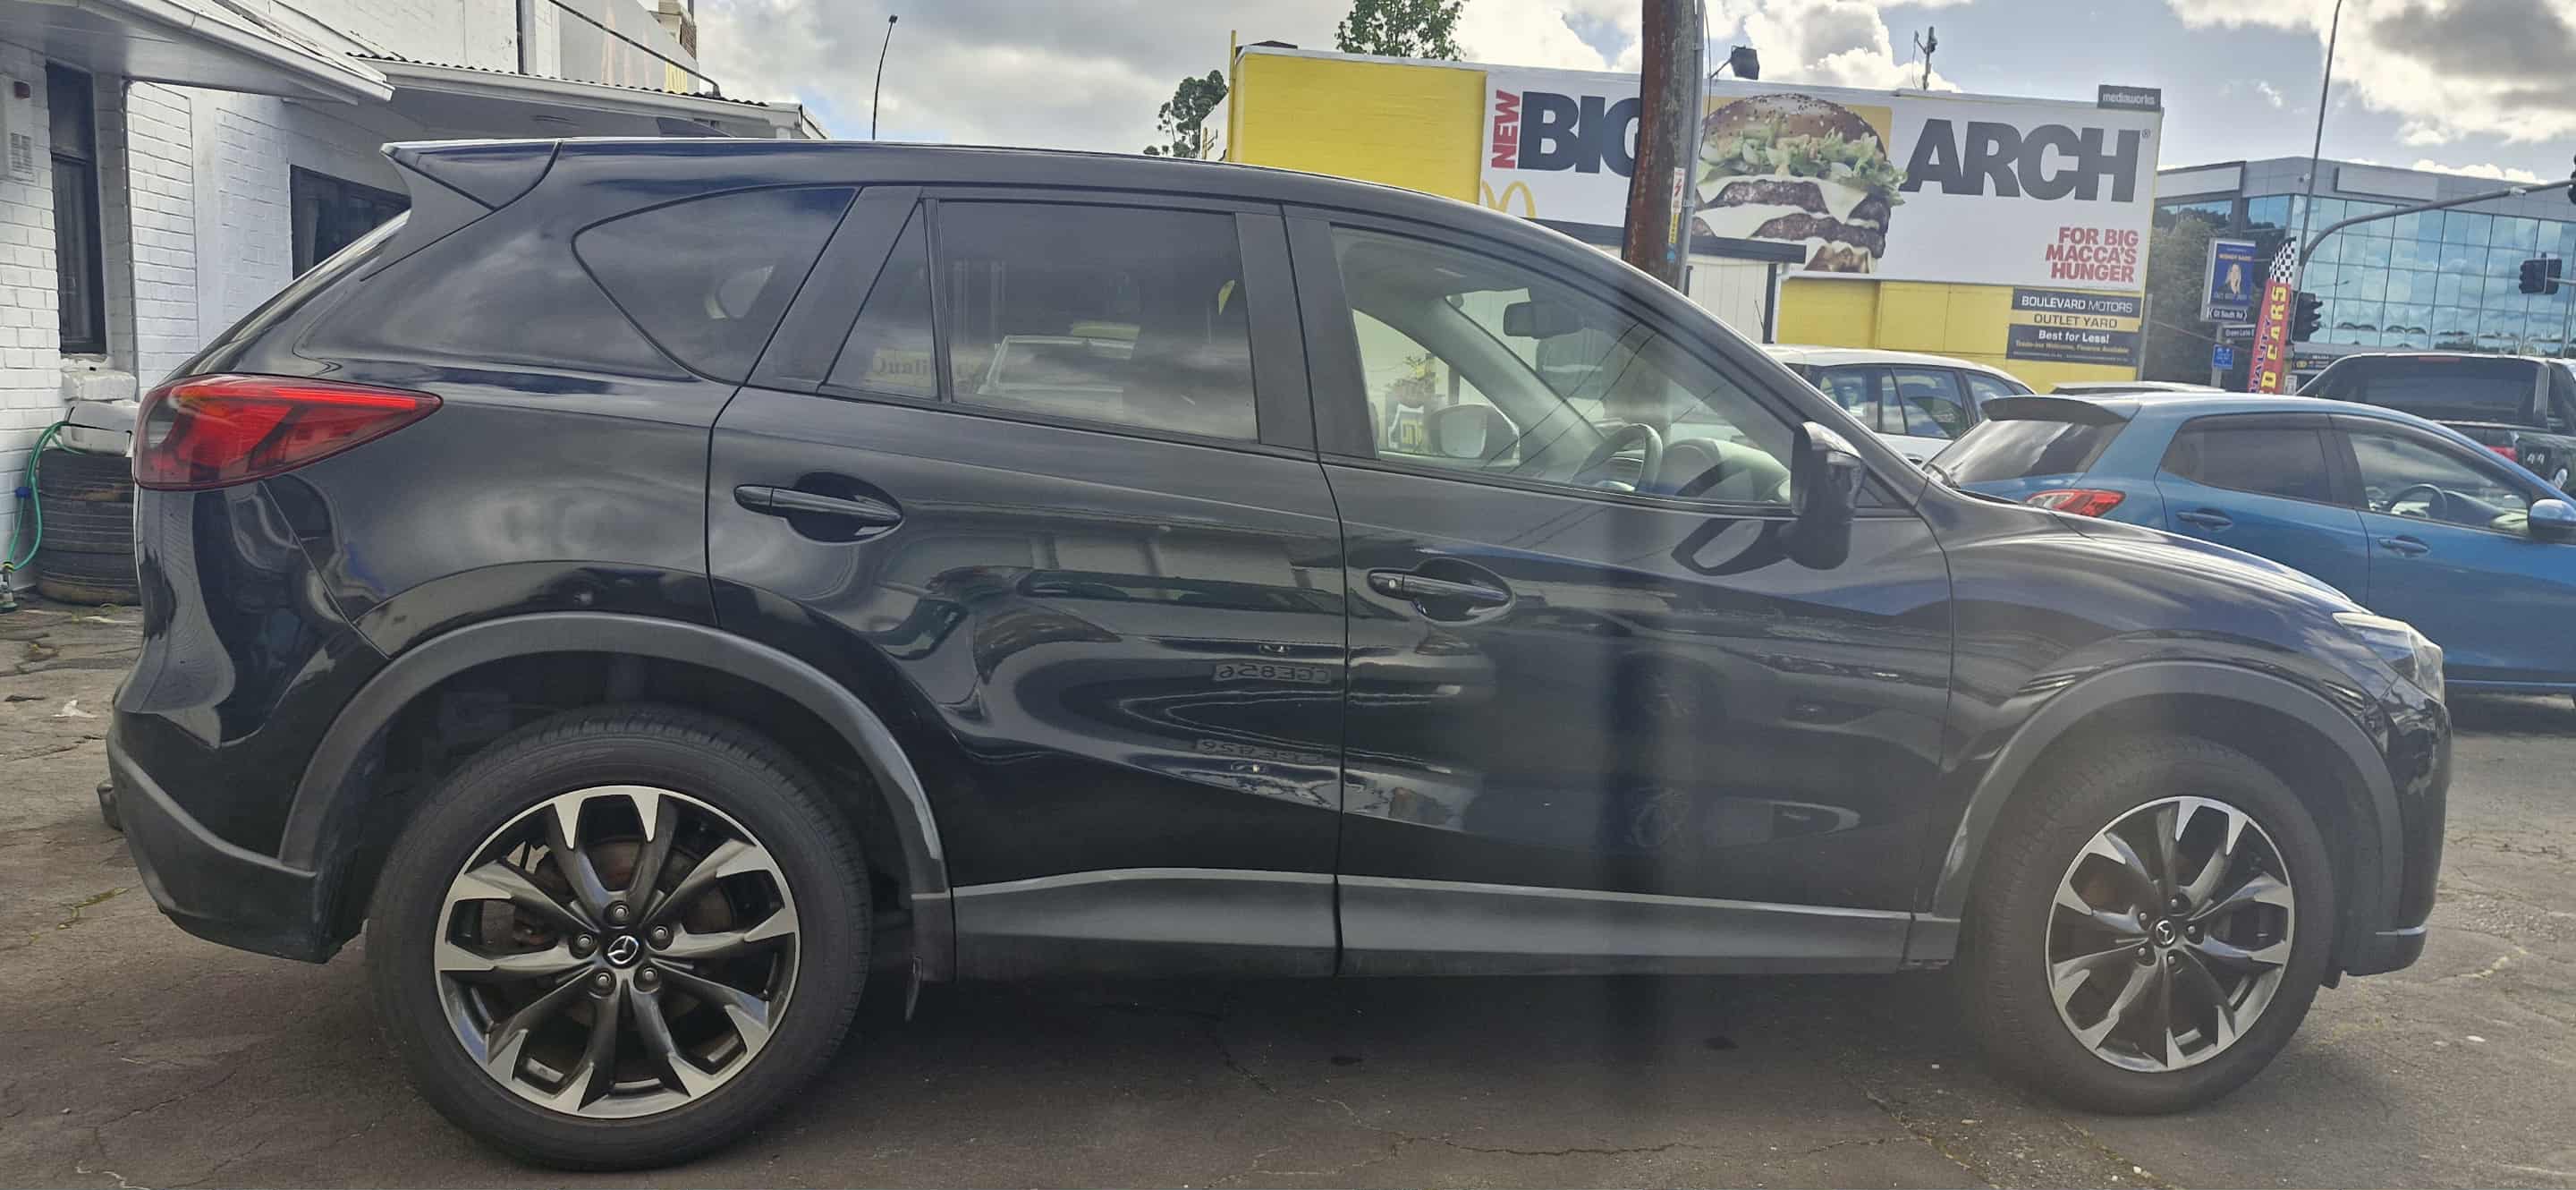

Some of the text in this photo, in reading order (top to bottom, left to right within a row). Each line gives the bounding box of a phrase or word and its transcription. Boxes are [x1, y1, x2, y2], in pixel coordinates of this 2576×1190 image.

[2102, 92, 2156, 105] mediaworks
[1491, 89, 1521, 169] NEW
[1898, 118, 2141, 202] ARCH
[2058, 226, 2139, 247] FOR BIG
[2045, 244, 2138, 266] MACCA'S
[2051, 262, 2134, 283] HUNGER
[2021, 295, 2133, 313] BOULEVARD MOTORS
[2034, 313, 2118, 328] OUTLET YARD
[2267, 285, 2286, 361] CARS
[2038, 329, 2110, 344] Best for Less!
[2249, 314, 2271, 394] UALITY
